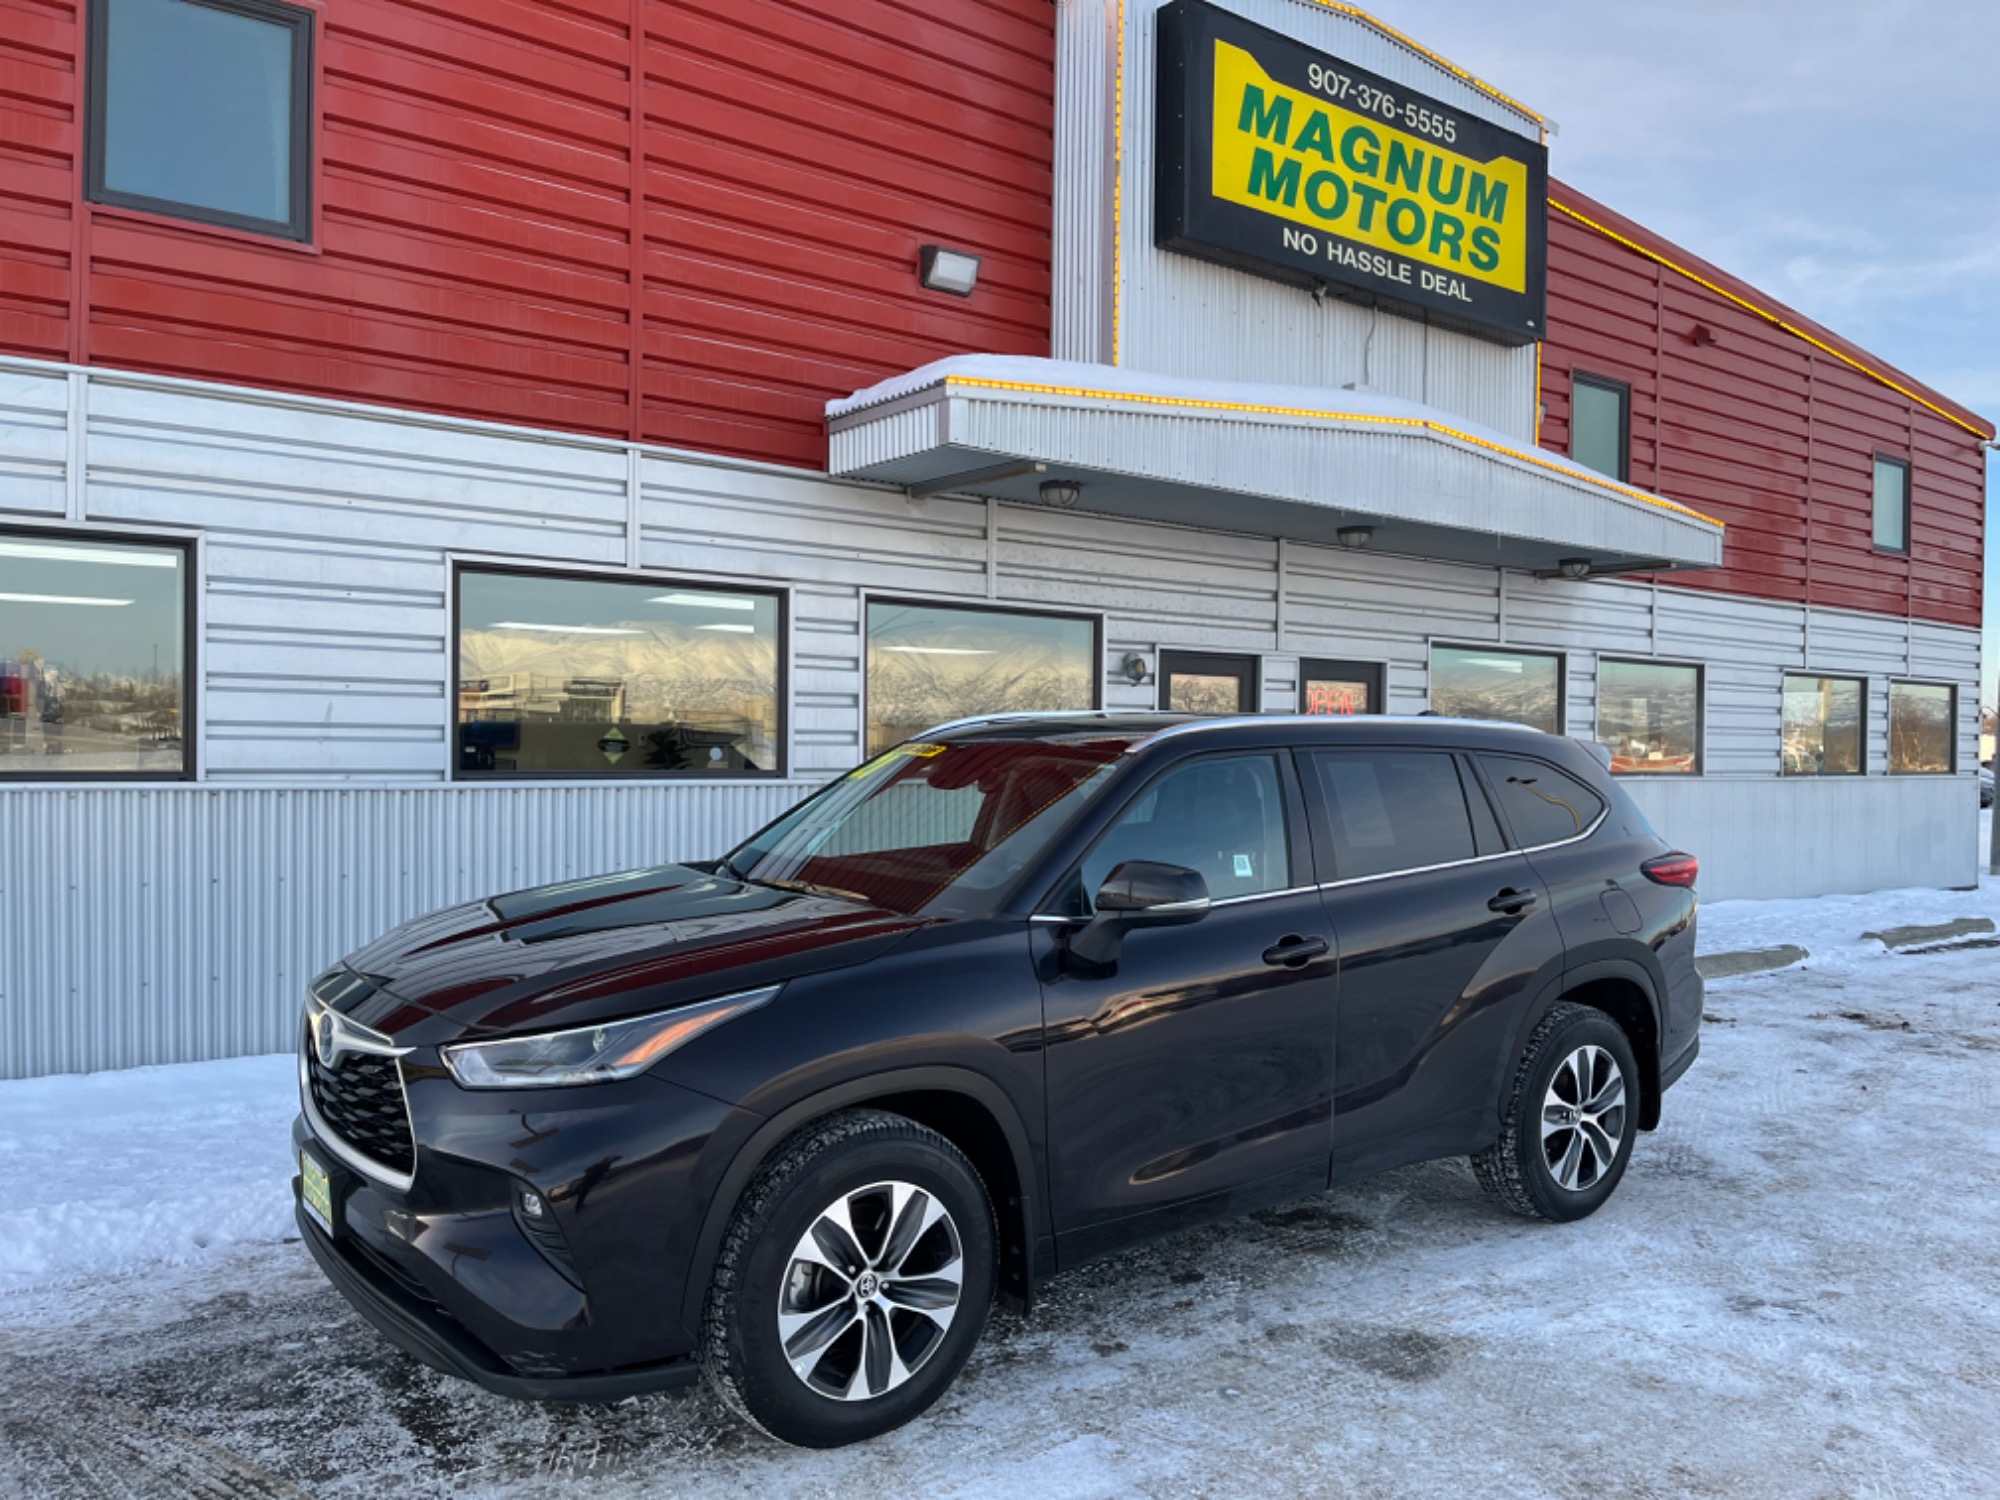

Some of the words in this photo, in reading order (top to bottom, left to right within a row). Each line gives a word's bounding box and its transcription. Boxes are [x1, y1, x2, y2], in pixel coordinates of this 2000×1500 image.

[1237, 82, 1509, 225] MAGNUM
[1308, 63, 1457, 143] 907-376-5555
[1247, 146, 1501, 273] MOTORS
[1283, 227, 1318, 256] NO
[1327, 241, 1412, 285] HASSLE
[1421, 270, 1473, 302] DEAL
